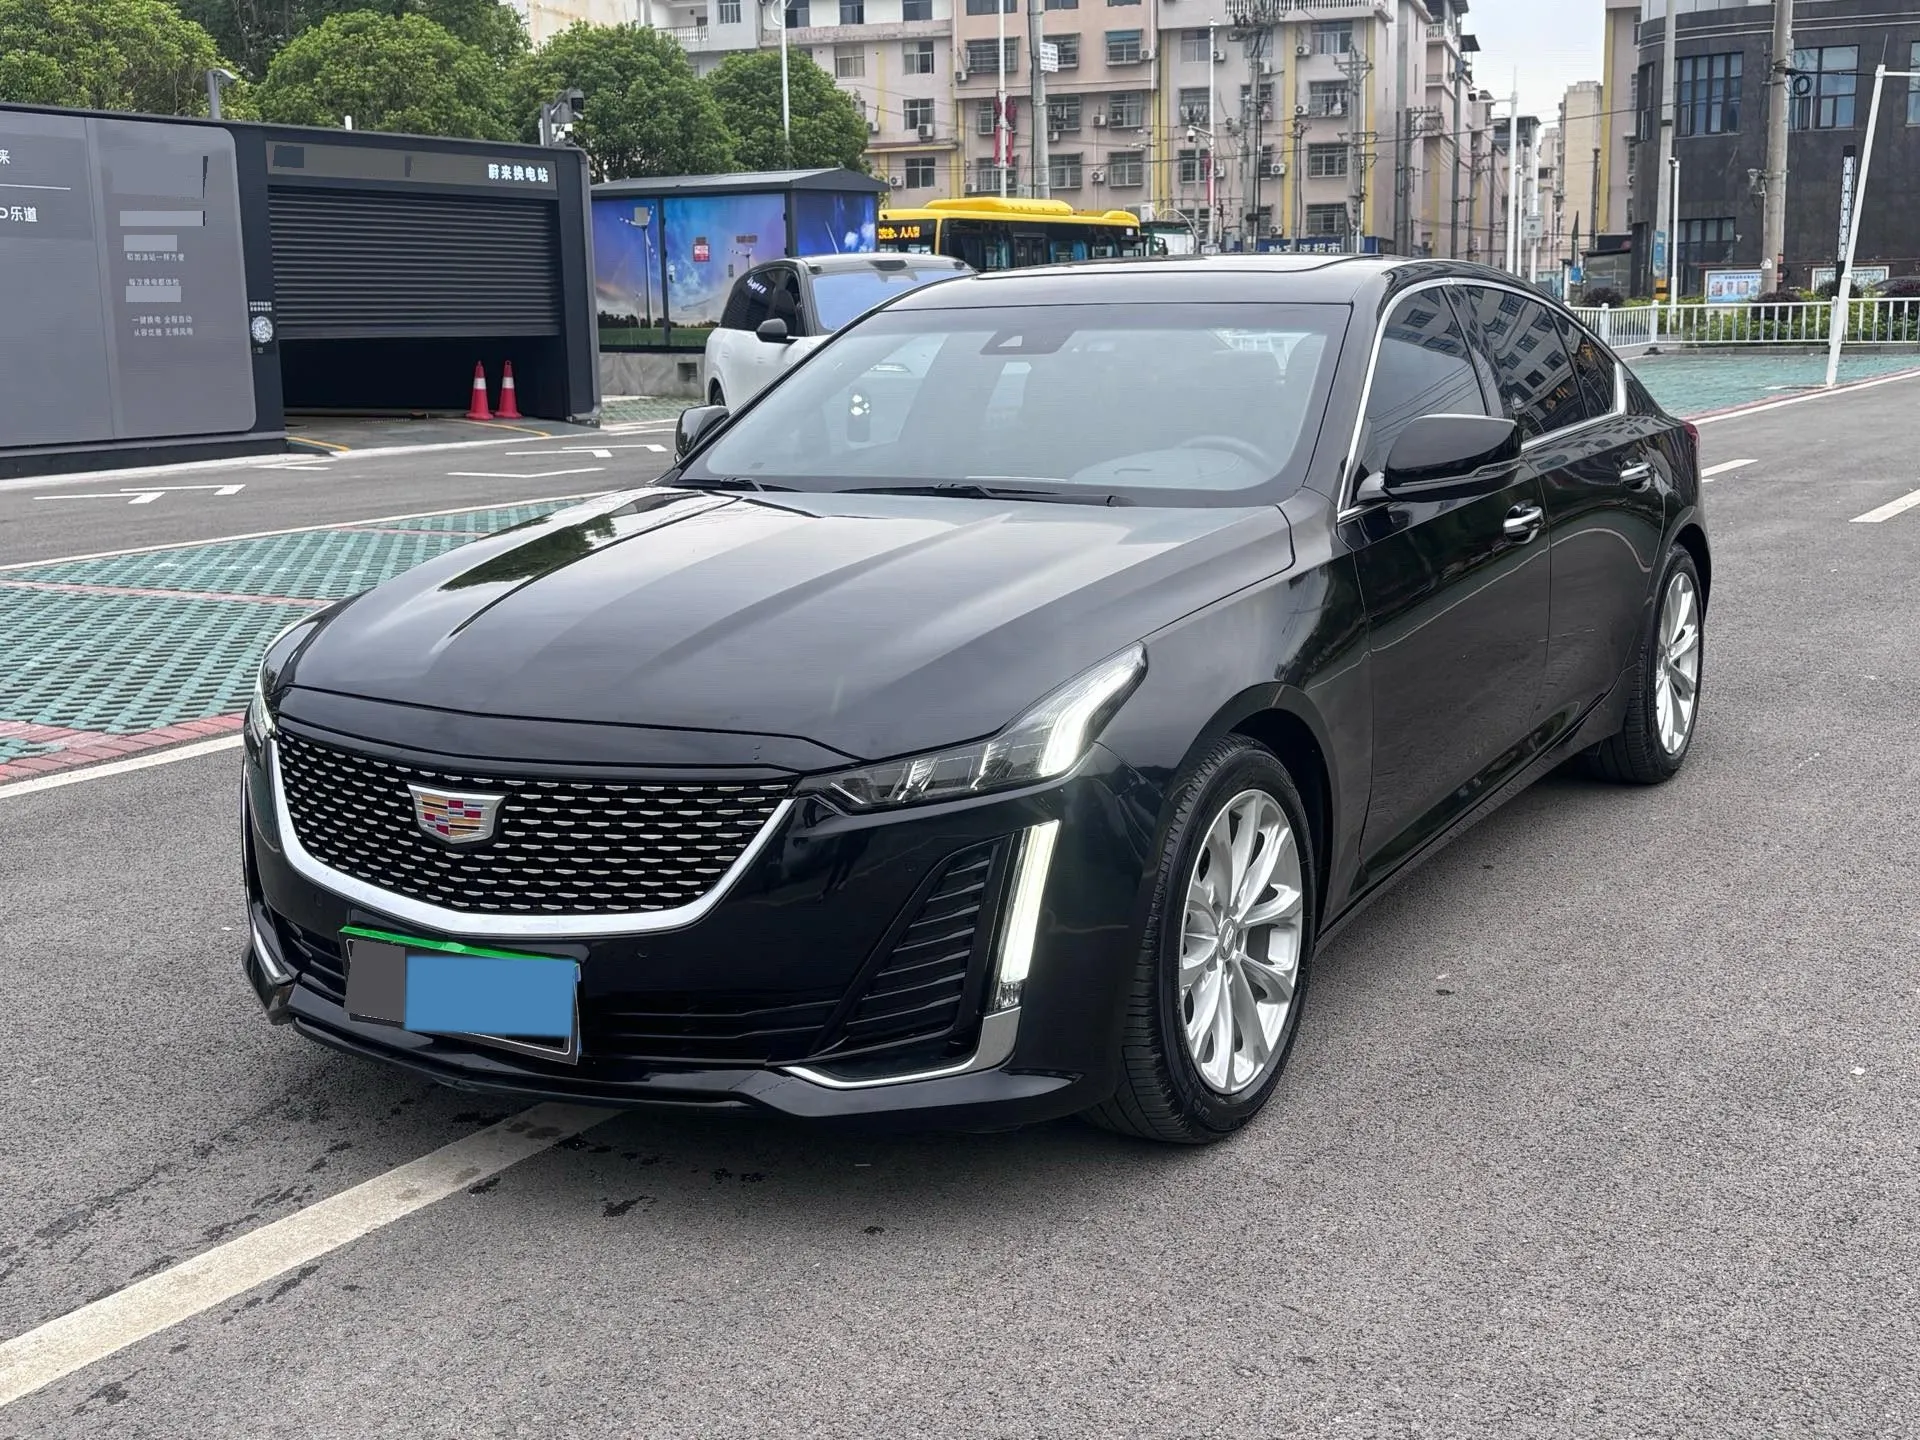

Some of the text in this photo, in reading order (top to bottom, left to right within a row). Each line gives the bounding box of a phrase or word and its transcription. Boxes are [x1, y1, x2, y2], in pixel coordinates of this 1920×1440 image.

[488, 163, 549, 183] 蔚来换电站
